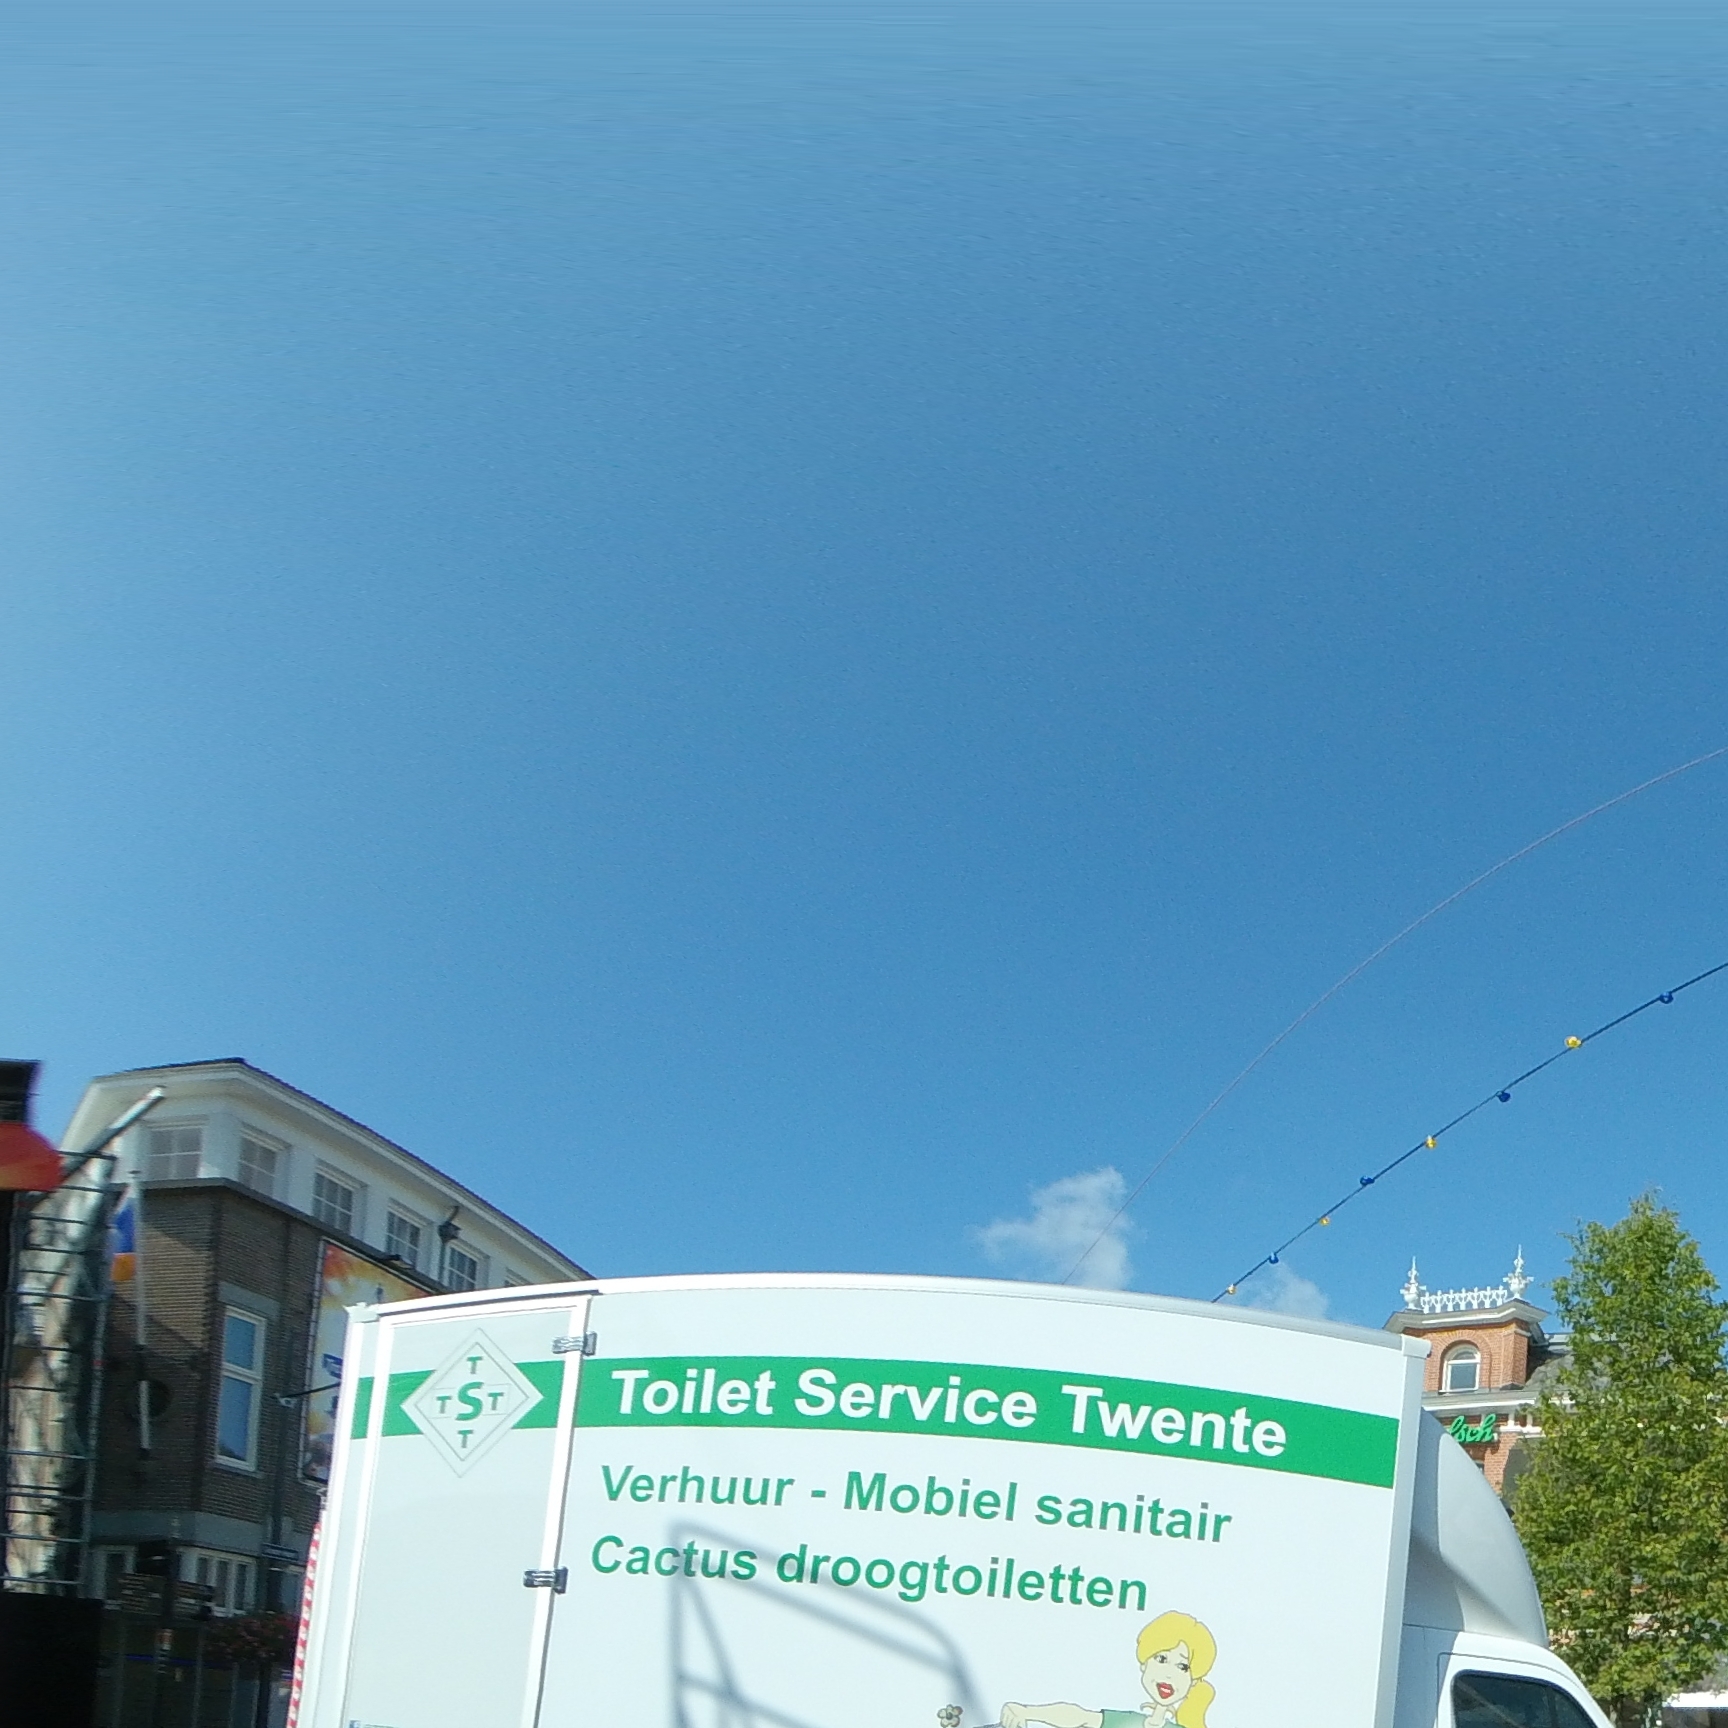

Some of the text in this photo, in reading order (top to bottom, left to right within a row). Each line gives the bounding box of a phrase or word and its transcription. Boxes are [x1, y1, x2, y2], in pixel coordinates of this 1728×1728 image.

[611, 1368, 1287, 1457] Toilet Service Twente
[601, 1465, 1233, 1543] Verhuur - Mobiel sanitair
[591, 1535, 1147, 1611] Cactus droogtoiletten
